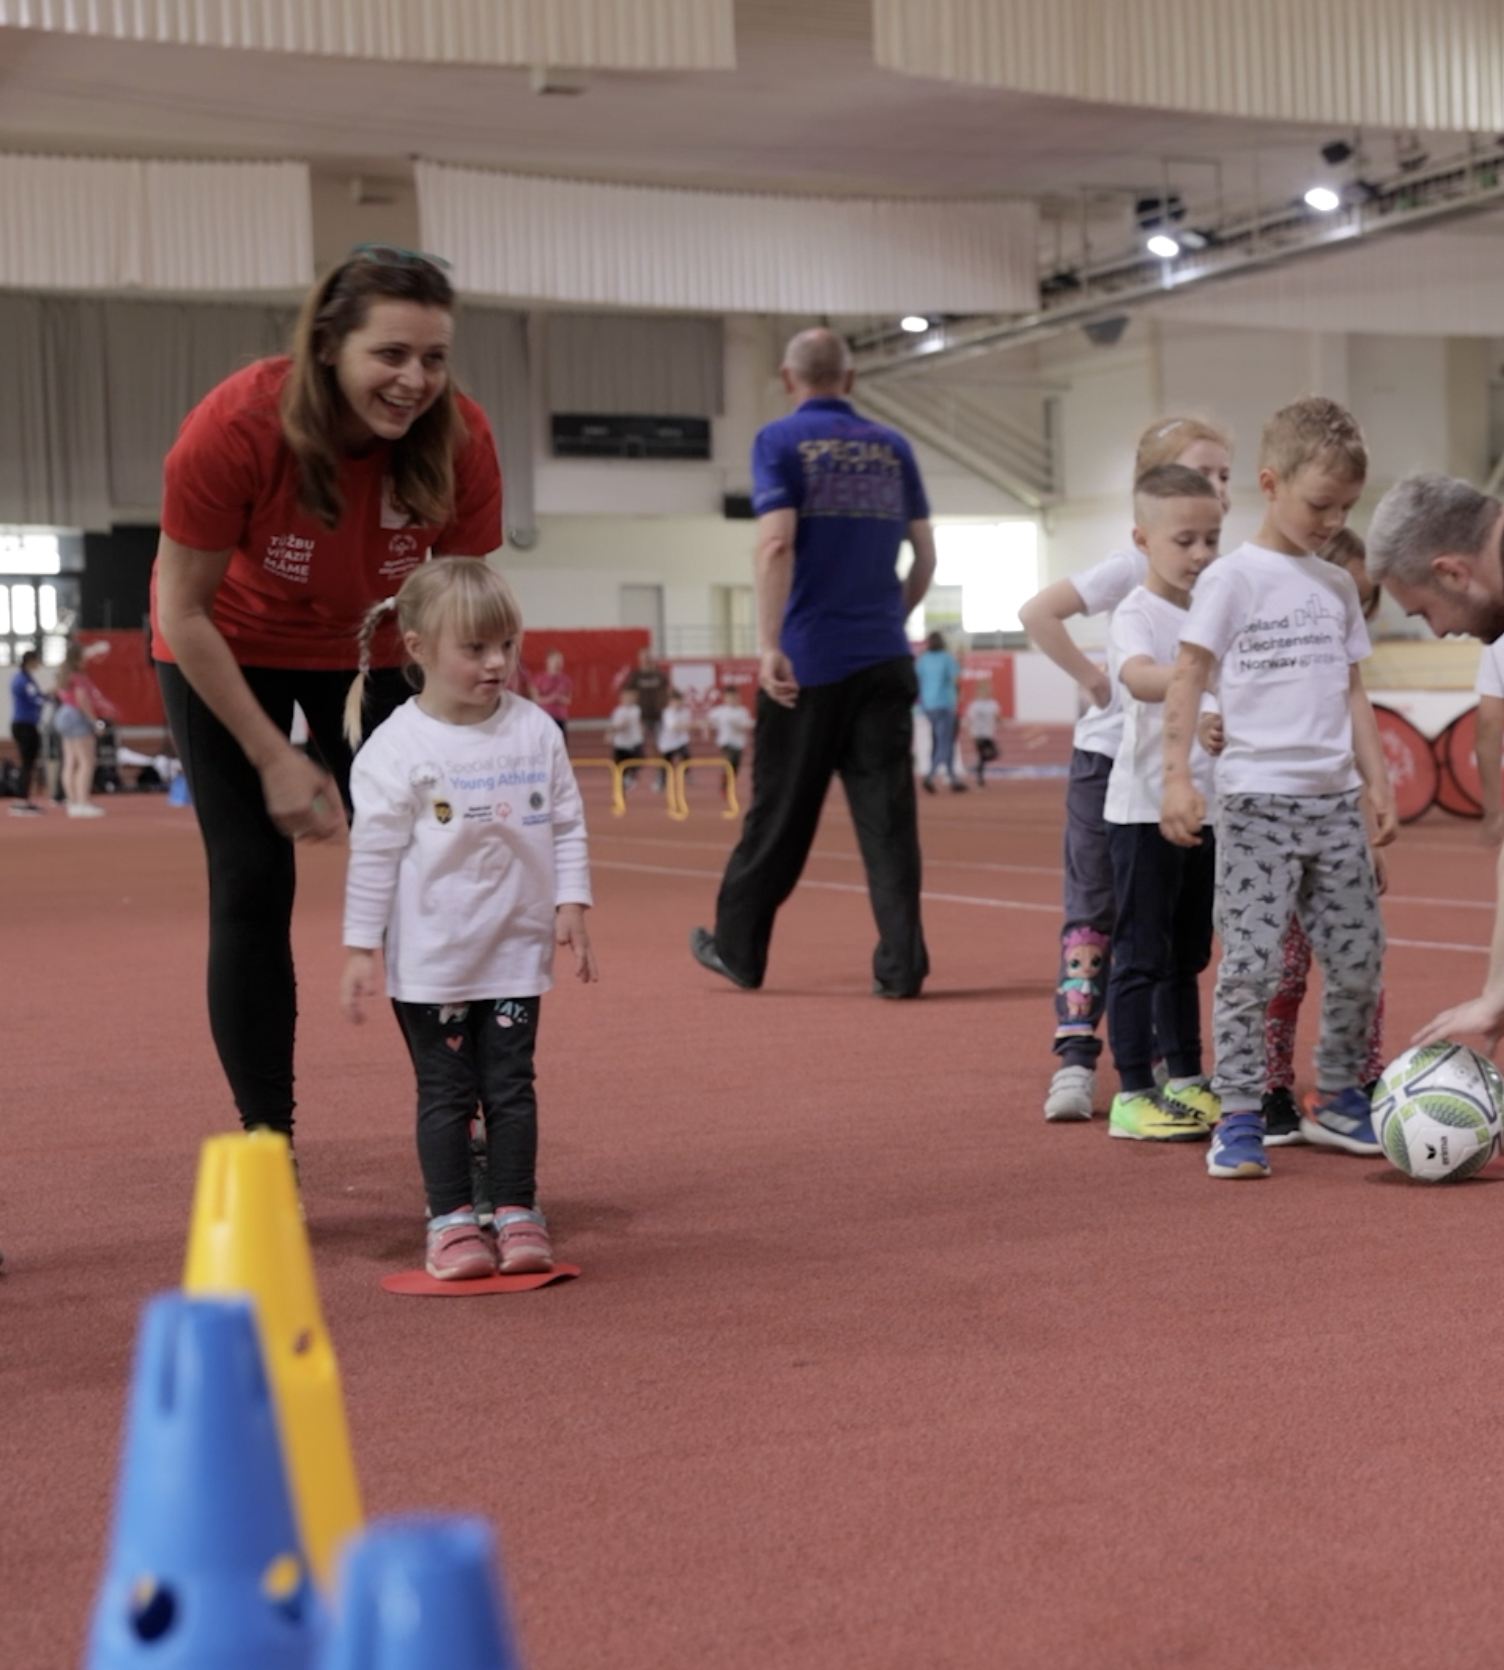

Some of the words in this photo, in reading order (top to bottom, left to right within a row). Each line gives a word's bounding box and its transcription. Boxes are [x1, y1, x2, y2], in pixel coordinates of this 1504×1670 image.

[1238, 632, 1332, 654] Liechtenstein
[1240, 656, 1297, 672] Norway
[445, 755, 494, 774] Special
[497, 752, 546, 773] Olympic
[450, 776, 495, 790] Young
[497, 770, 548, 787] Athlete
